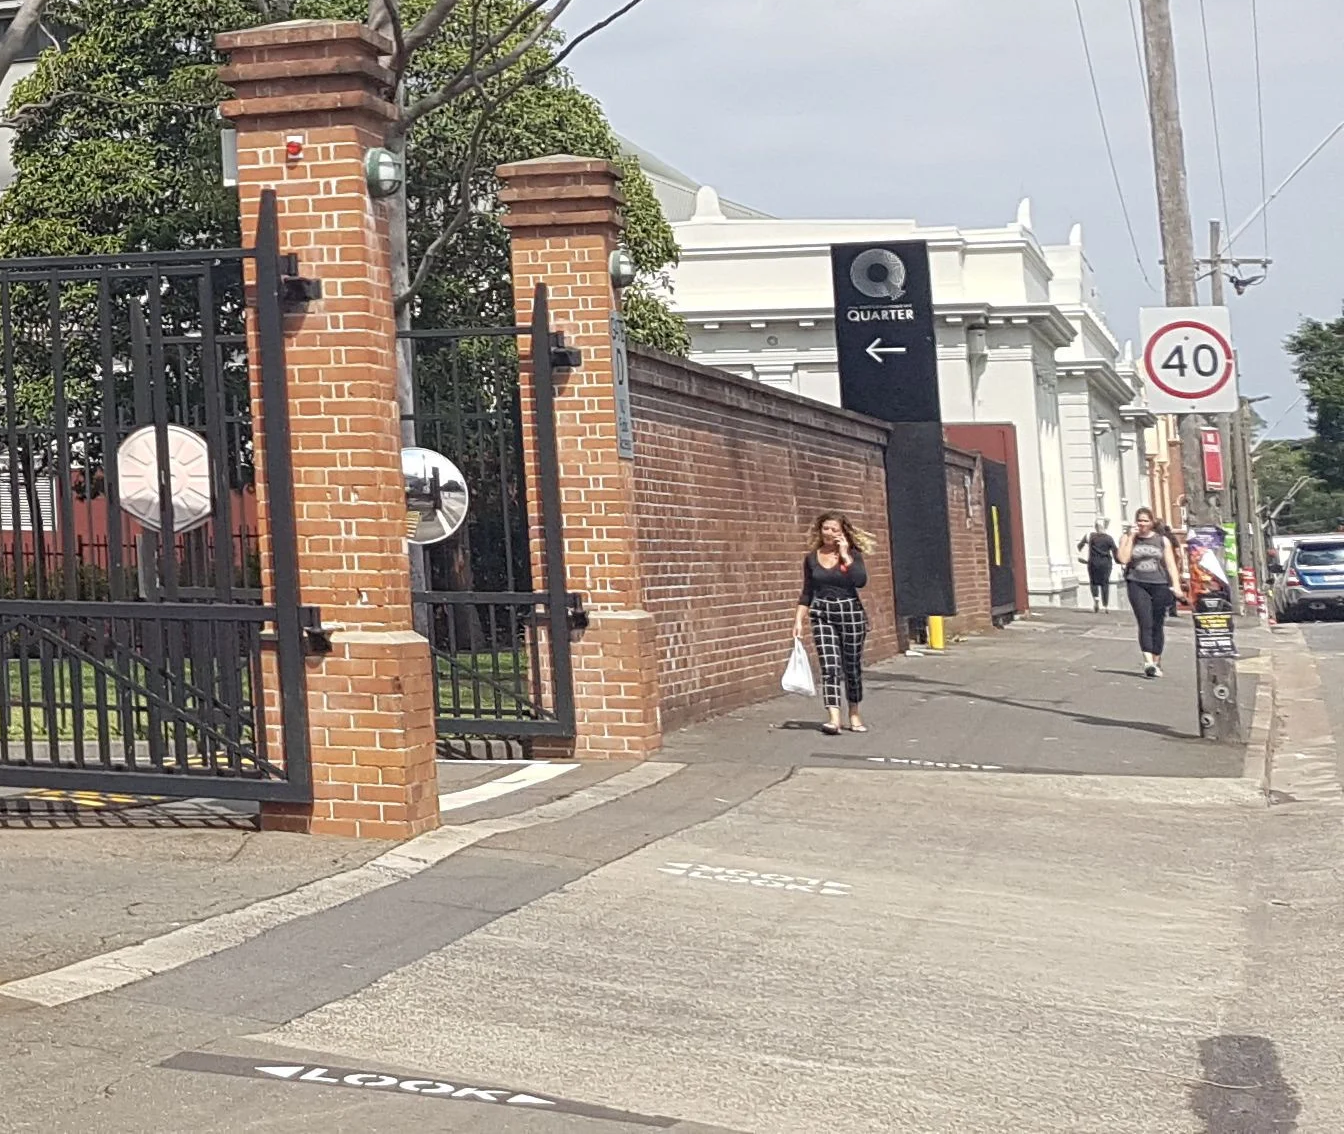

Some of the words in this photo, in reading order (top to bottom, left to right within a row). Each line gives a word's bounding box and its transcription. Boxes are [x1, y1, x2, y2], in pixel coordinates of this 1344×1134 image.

[847, 308, 914, 322] QUARTER
[1160, 343, 1219, 378] 40
[687, 870, 815, 894] LOOK
[299, 1067, 511, 1102] LOOK
